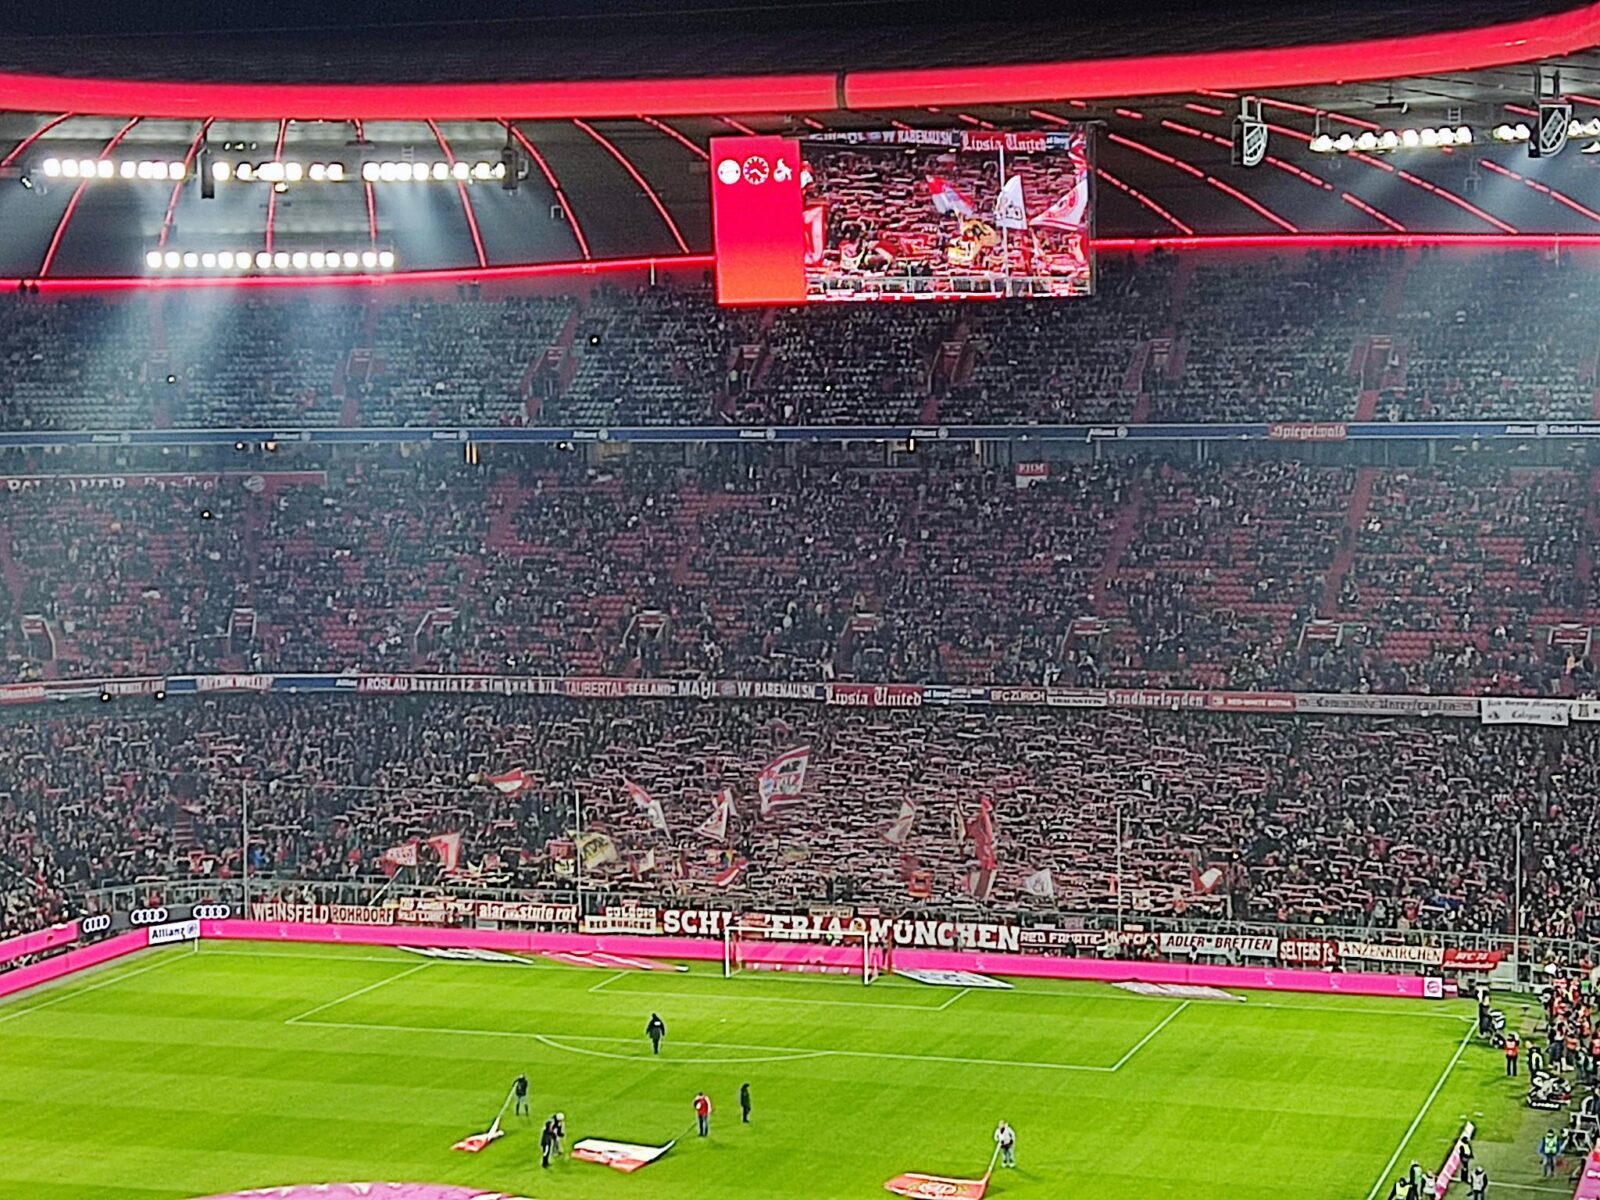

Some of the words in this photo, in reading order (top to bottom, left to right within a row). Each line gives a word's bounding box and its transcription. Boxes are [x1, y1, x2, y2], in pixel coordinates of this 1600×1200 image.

[911, 429, 937, 437] Allianz
[565, 681, 624, 696] TAUBERTAL
[824, 684, 868, 705] Lipsia
[874, 686, 922, 706] United
[252, 902, 330, 924] WEINSFELD
[331, 906, 394, 924] ROHRDORF
[479, 902, 555, 920] alarstufe
[152, 928, 185, 939] Allianz
[663, 909, 843, 940] SCHIERIA
[869, 917, 1020, 951] MÜNCHEN
[1166, 935, 1205, 948] ADLER
[1215, 937, 1273, 951] BRETTEN
[1342, 943, 1440, 961] ANZENKIRCHEN
